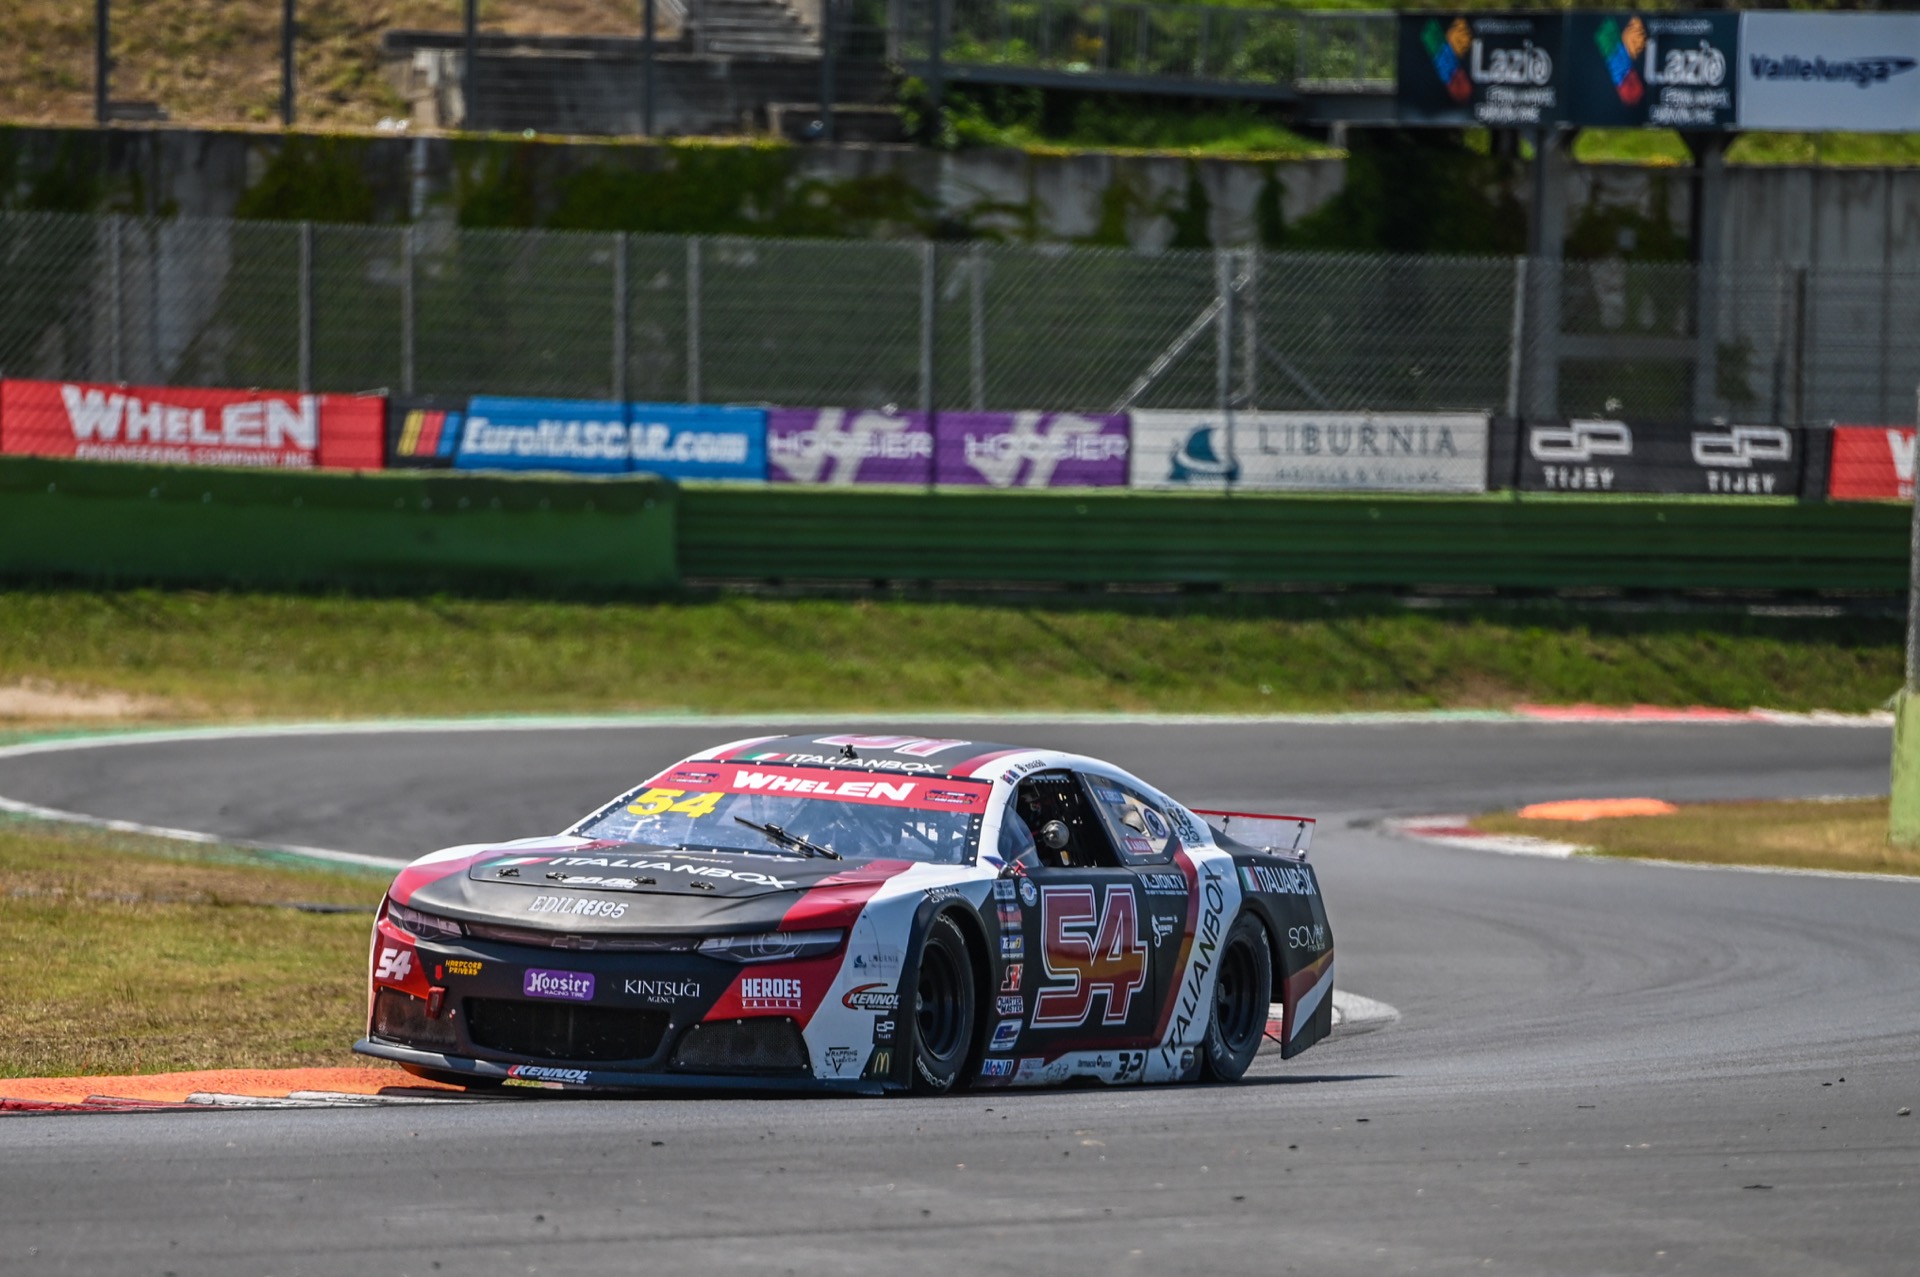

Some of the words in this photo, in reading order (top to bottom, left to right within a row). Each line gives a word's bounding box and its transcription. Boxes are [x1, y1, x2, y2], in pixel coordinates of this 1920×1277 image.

[61, 384, 319, 449] WHELEN
[461, 417, 748, 463] EuroNASCAR.com
[769, 430, 934, 460] HOOSIER
[964, 432, 1130, 461] HOOSIER
[1258, 423, 1458, 457] LIBURNIA
[784, 753, 943, 774] ITALIANBOX
[733, 770, 916, 801] WHELEN
[627, 787, 726, 819] 54
[549, 856, 798, 889] ITALIANBOX
[1254, 865, 1316, 895] ITALIANBOX
[375, 947, 412, 981] 54
[1029, 883, 1149, 1029] 54
[1160, 860, 1224, 1070] ITALIANBOX
[449, 967, 478, 976] DRIVERS
[526, 972, 590, 993] Hoosier
[646, 995, 676, 1004] AGENCY
[741, 977, 801, 998] HEROES
[848, 993, 899, 1006] KENNOL
[741, 999, 801, 1007] VALLEY
[1001, 1003, 1023, 1013] MASTER
[513, 1064, 588, 1081] KENNOL
[983, 1060, 1006, 1076] Mobil
